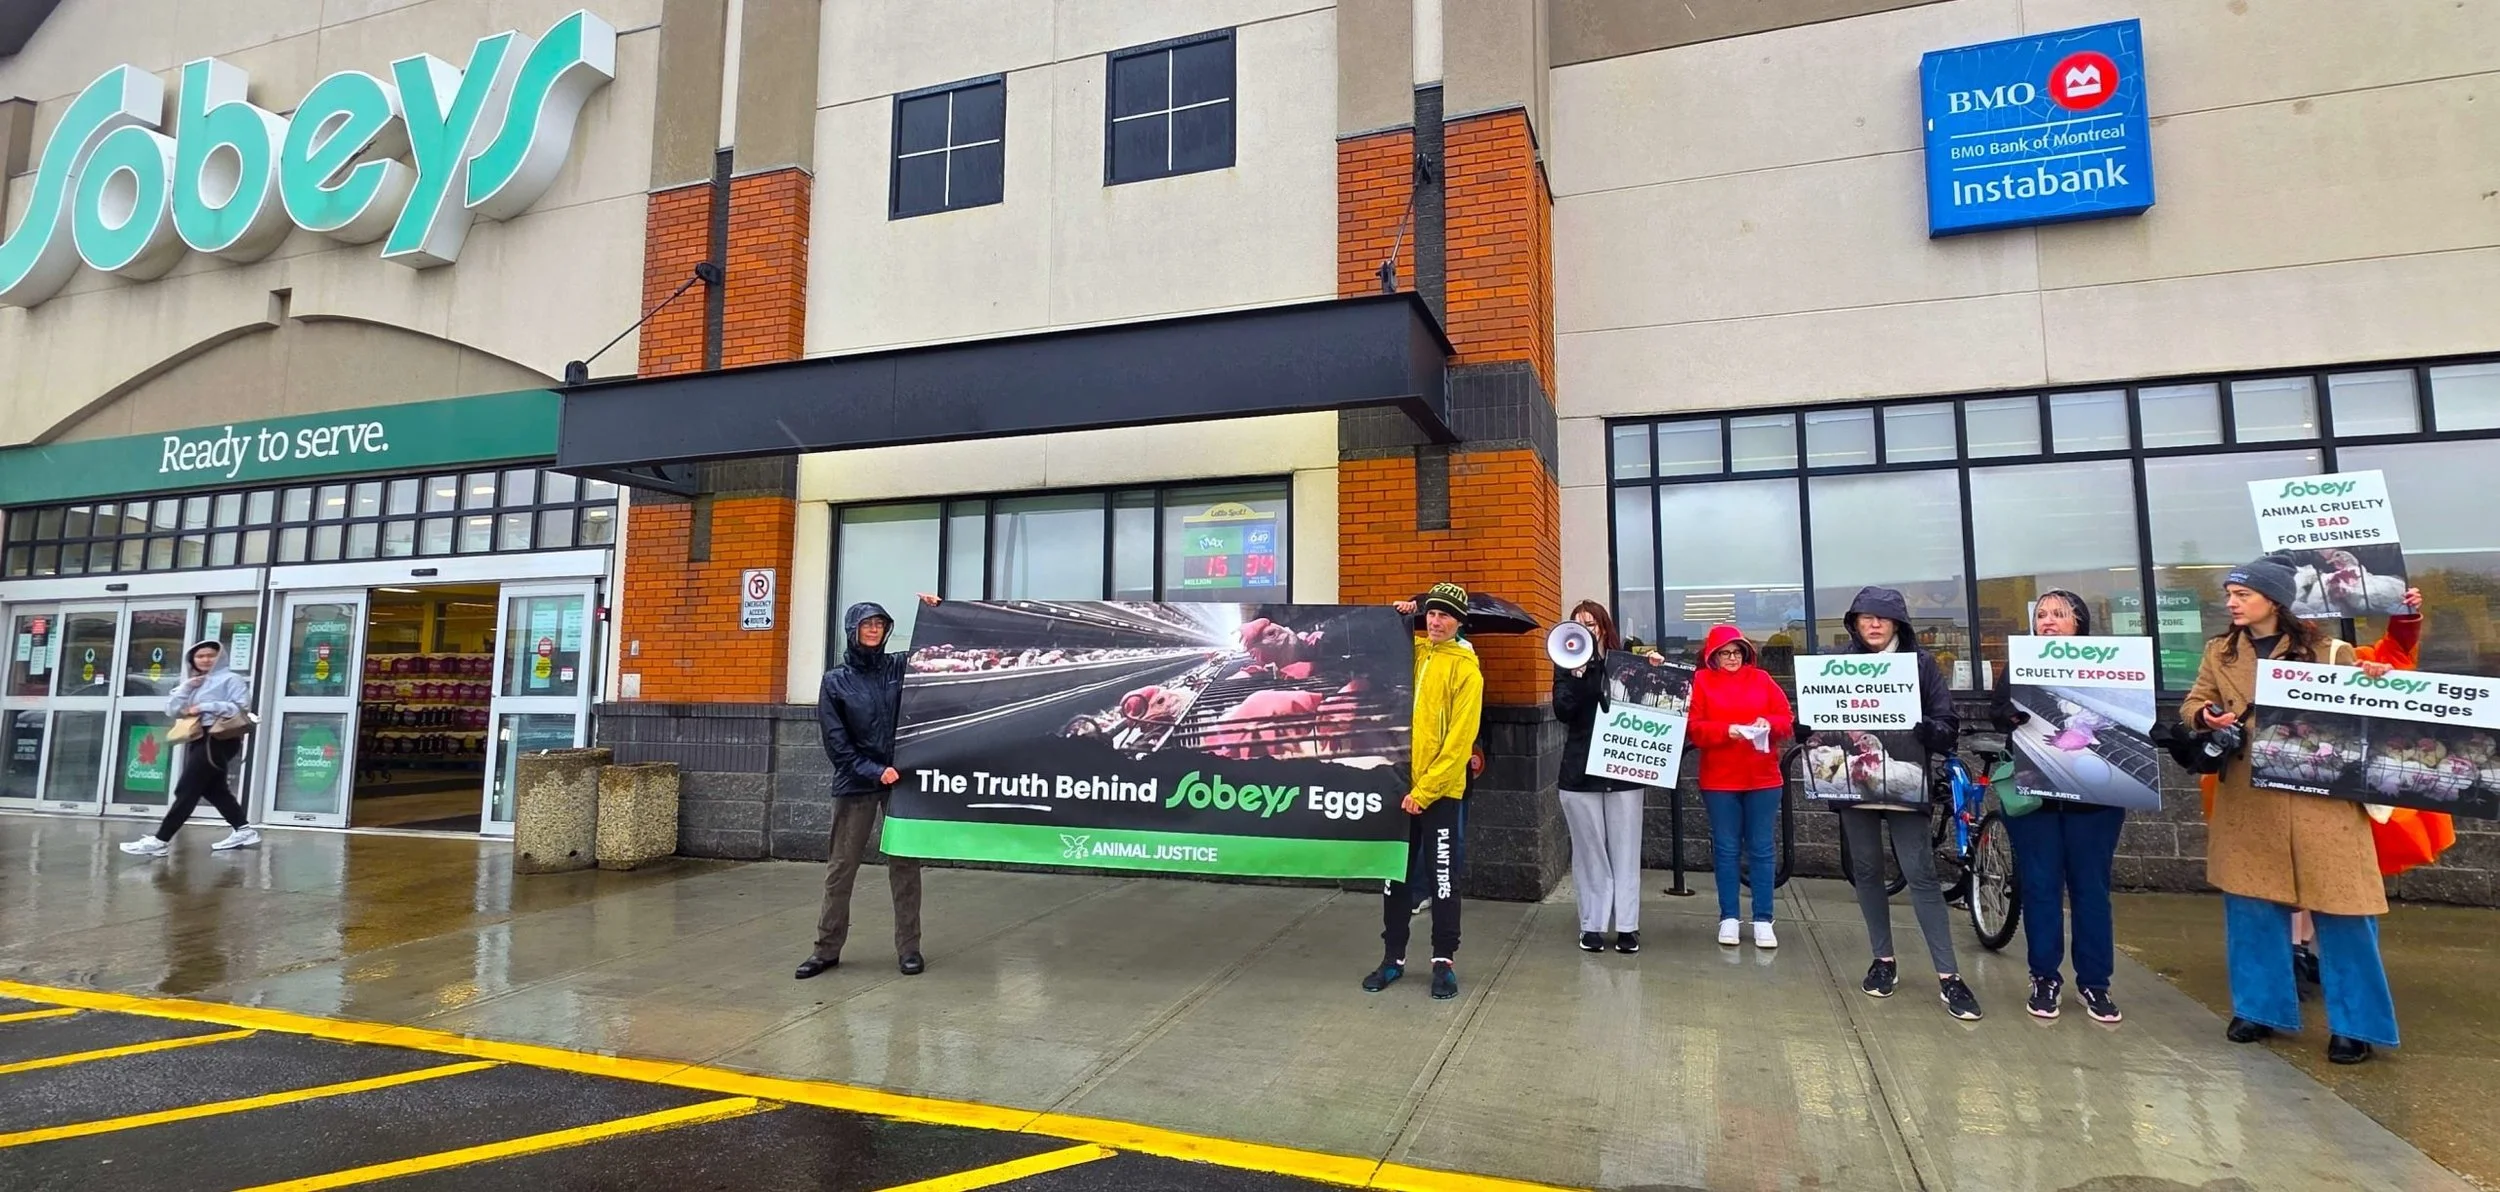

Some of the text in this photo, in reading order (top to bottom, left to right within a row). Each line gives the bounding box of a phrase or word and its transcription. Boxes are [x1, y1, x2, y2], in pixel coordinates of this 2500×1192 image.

[1948, 82, 2036, 114] BMO
[1951, 123, 2126, 160] BMO Bank of Montreal
[0, 8, 605, 302] Sobeys
[1953, 157, 2129, 206] Instabank
[159, 420, 389, 479] Ready to serve.
[2280, 480, 2357, 498] Sobeys
[2262, 499, 2384, 518] ANIMAL CRUELTY
[2301, 516, 2350, 529] IS BAD
[2278, 528, 2381, 545] FOR BUSINESS
[1207, 555, 1228, 577] 15
[2038, 640, 2119, 663] Sobeys
[1820, 659, 1891, 678] Sobeys
[2015, 667, 2146, 681] CRUELTY EXPOSED
[1802, 683, 1914, 694] ANIMAL CRUELTY
[2272, 668, 2313, 683] 80%
[2318, 672, 2337, 684] of
[2438, 683, 2490, 701] Eggs
[1836, 699, 1880, 709] IS BAD
[2287, 688, 2473, 718] Come from Cages
[1609, 711, 1672, 737] Sobeys
[1813, 713, 1906, 723] FOR BUSINESS
[1602, 733, 1673, 754] CRUEL CAGE
[1603, 748, 1667, 767] PRACTICES
[128, 767, 164, 780] Canadian
[1605, 763, 1659, 780] EXPOSED
[916, 769, 1382, 820] The Truth Behind Sobeys Eggs
[1092, 841, 1218, 862] ANIMAL JUSTICE
[1437, 828, 1450, 867] PLANT
